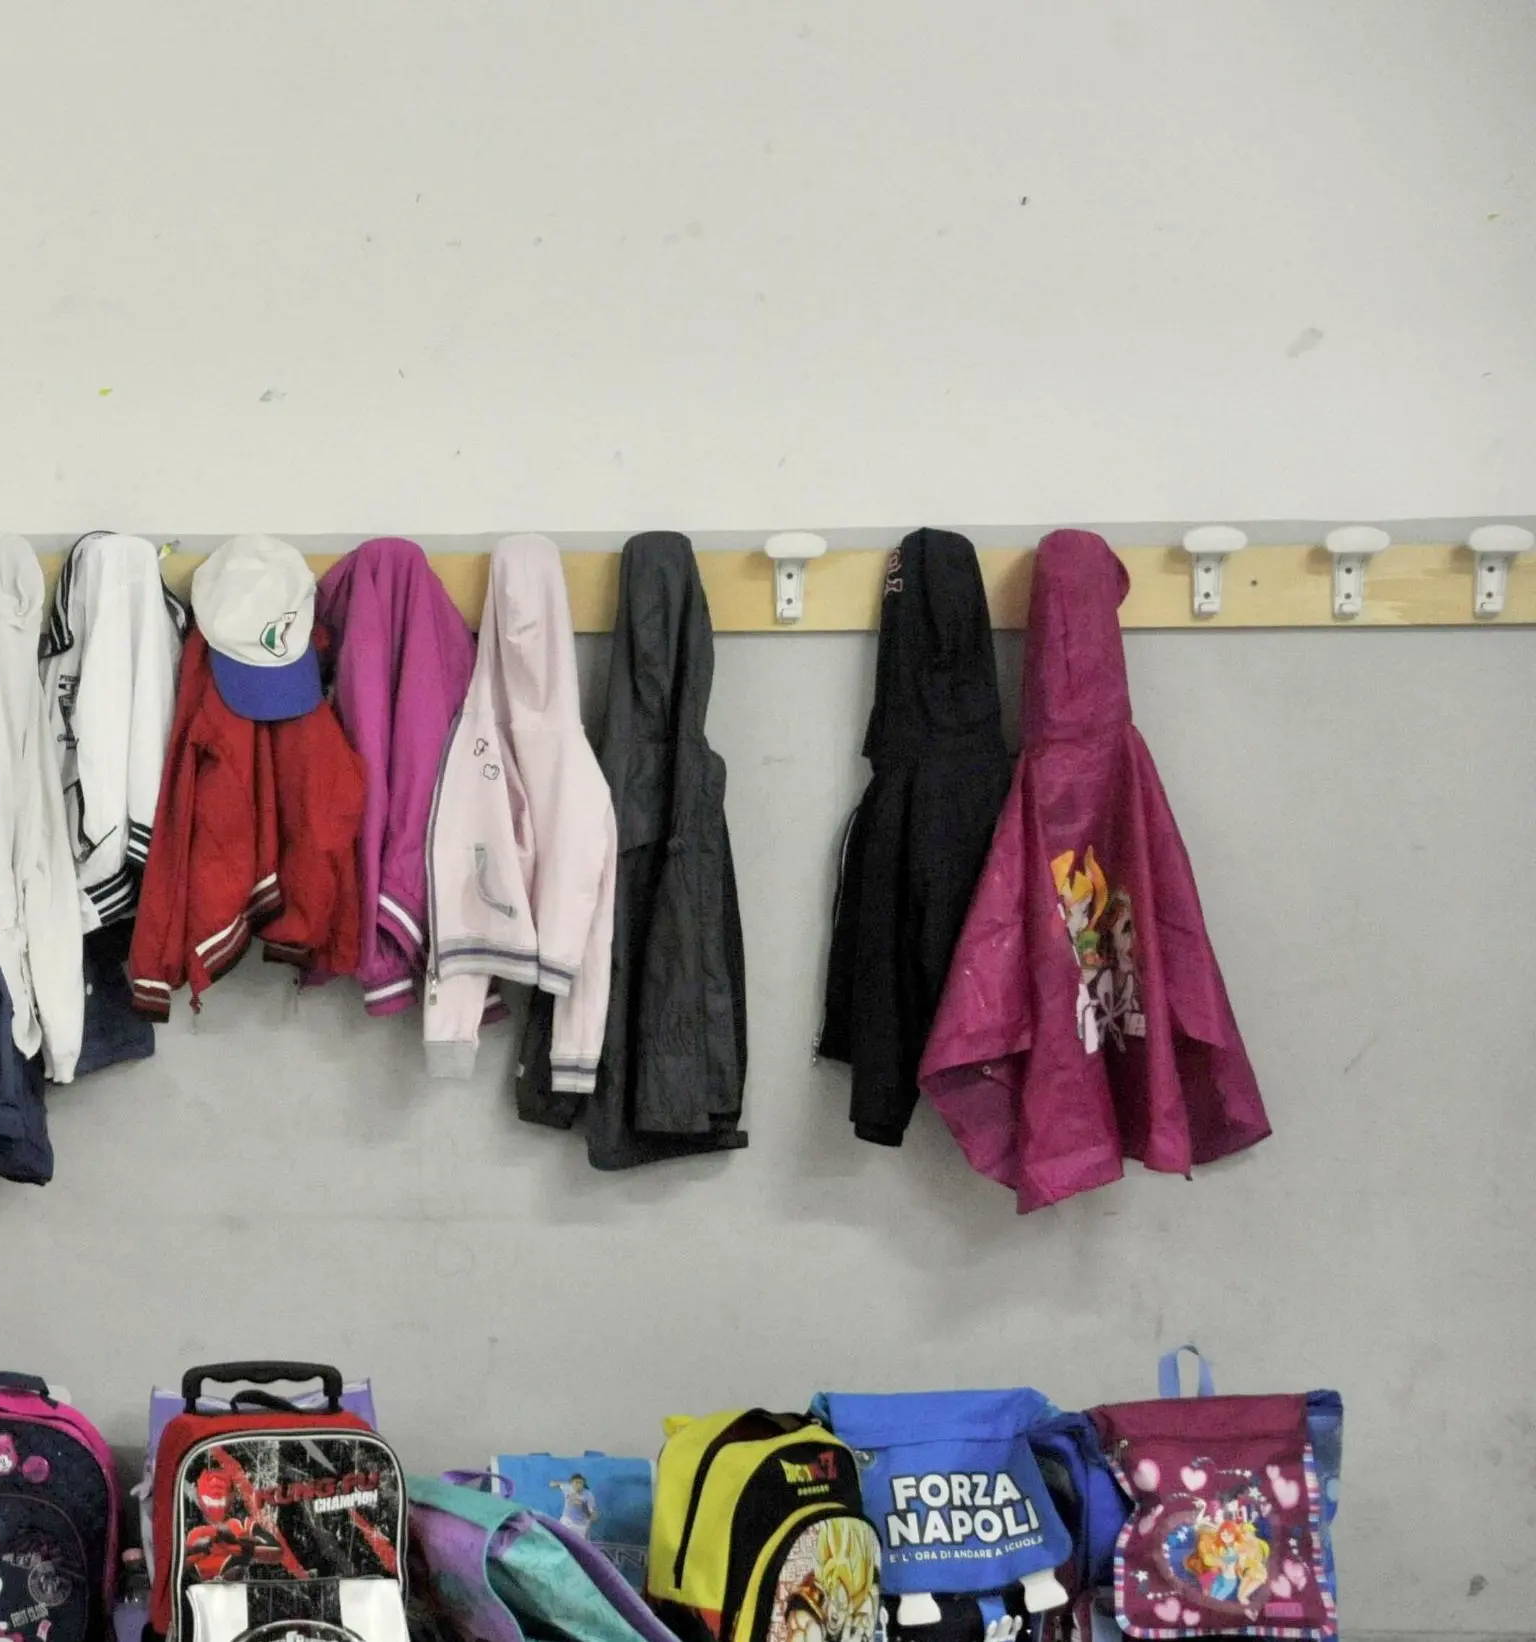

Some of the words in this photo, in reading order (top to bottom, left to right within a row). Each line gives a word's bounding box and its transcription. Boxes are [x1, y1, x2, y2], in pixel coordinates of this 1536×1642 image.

[314, 1489, 378, 1513] CHAMPION
[892, 1473, 1021, 1510] FORZA
[887, 1498, 1039, 1547] NAPOLI
[915, 1551, 938, 1561] ORA
[940, 1550, 951, 1560] DI
[954, 1549, 993, 1559] ANDARE
[995, 1547, 1003, 1557] A
